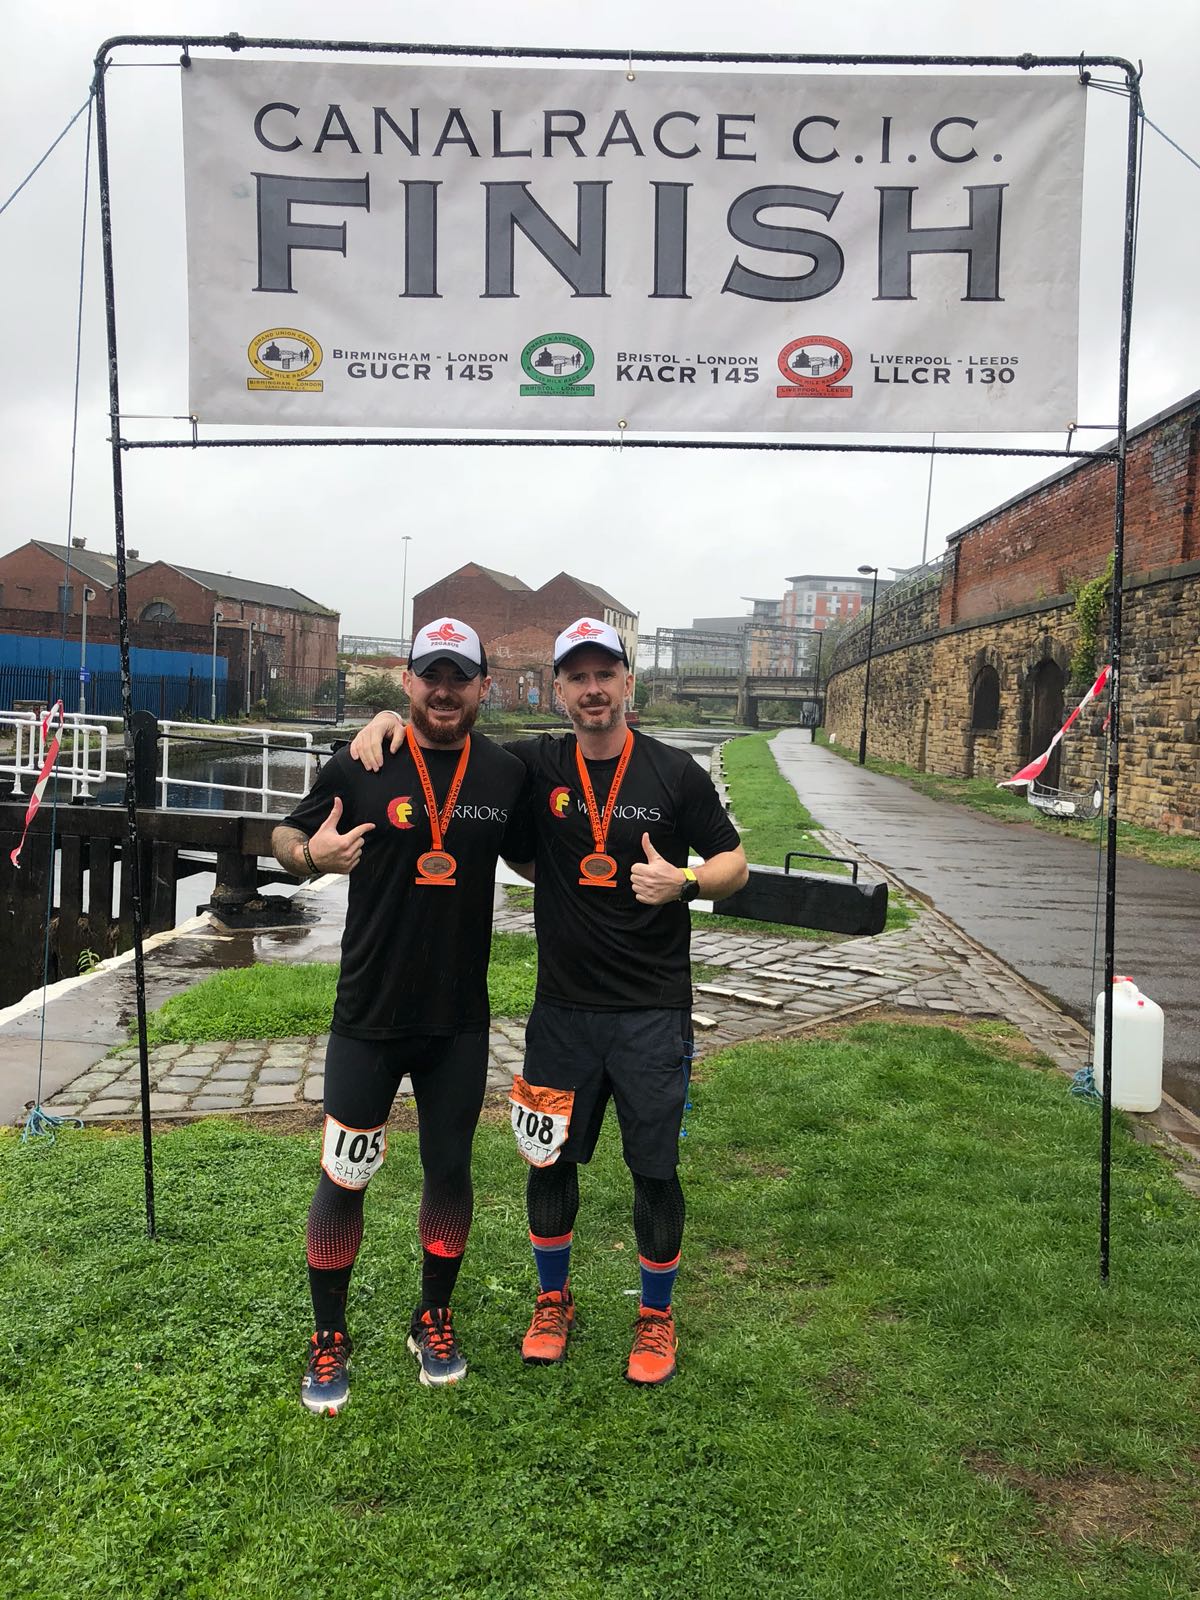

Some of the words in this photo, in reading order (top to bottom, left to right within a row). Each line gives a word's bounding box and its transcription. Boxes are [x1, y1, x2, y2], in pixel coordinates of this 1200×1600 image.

[253, 102, 757, 162] CANALRACE
[792, 115, 1003, 164] C.I.C.
[250, 172, 1010, 302] FINISH
[332, 349, 431, 362] BIRMINGHAM
[447, 352, 509, 363] LONDON
[616, 352, 681, 365] BRISTOL
[696, 354, 759, 366] LONDON
[870, 353, 952, 366] LIVERPOOL
[968, 355, 1019, 366] LEEDS
[347, 362, 431, 381] GUCR
[445, 364, 495, 382] 145
[616, 365, 697, 383] KACR
[710, 366, 760, 384] 145
[873, 366, 951, 384] LLCR
[965, 367, 1016, 384] 130
[517, 1105, 554, 1145] 108
[334, 1129, 382, 1163] 105
[334, 1161, 371, 1180] RHYS
